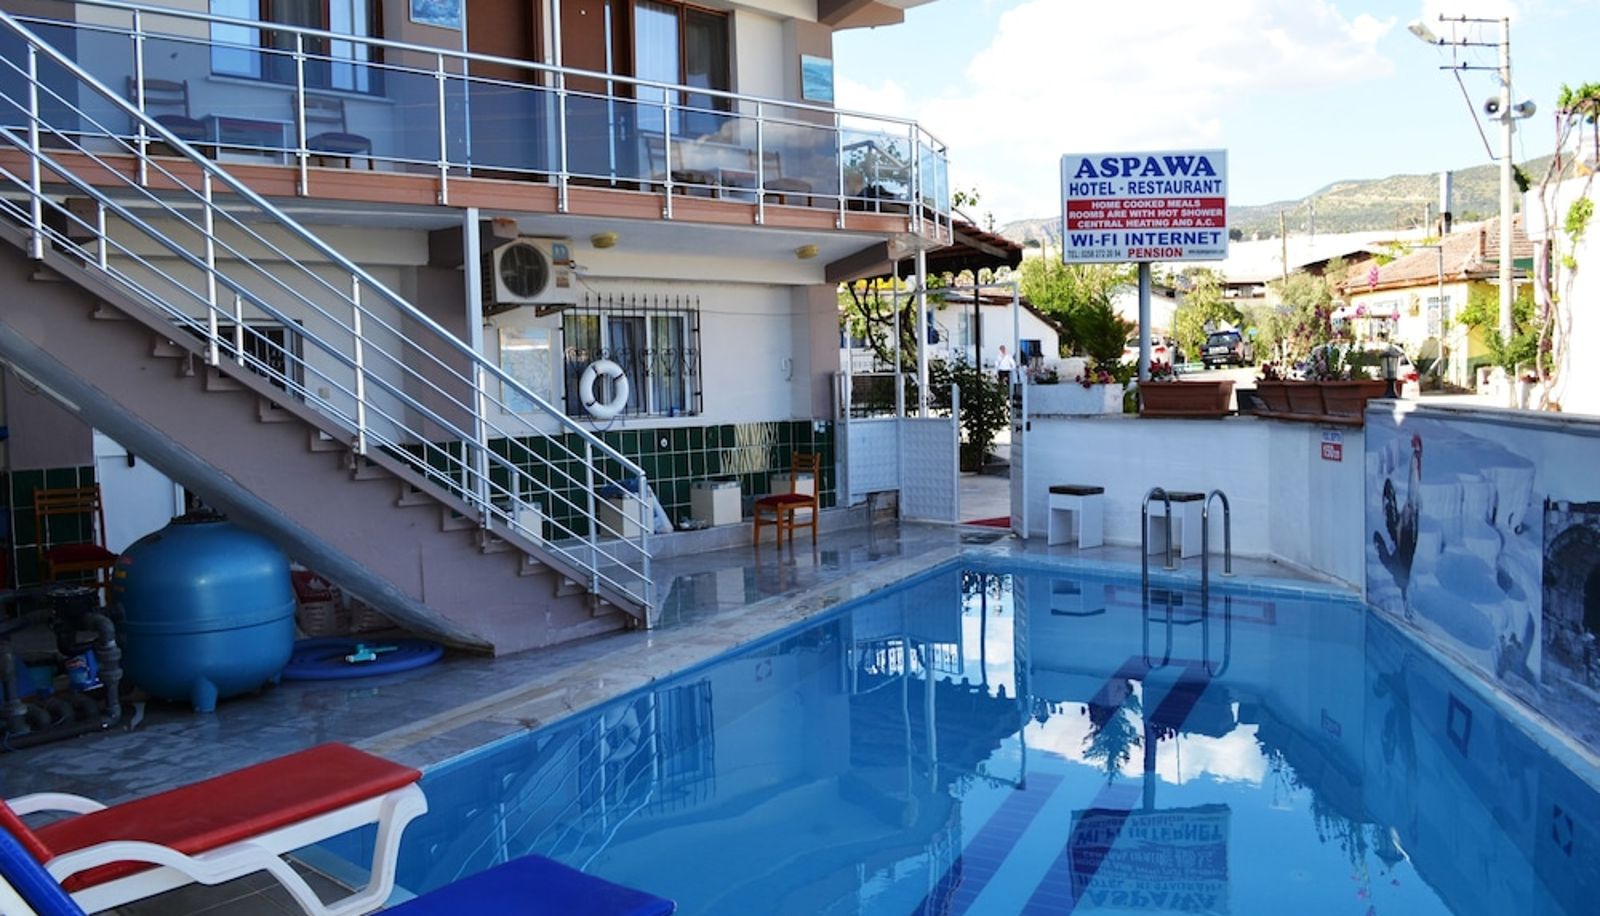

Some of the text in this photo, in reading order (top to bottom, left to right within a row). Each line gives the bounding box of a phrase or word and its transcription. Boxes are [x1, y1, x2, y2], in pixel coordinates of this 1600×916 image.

[1074, 156, 1217, 179] ASPAWA
[1069, 182, 1116, 196] HOTEL
[1127, 180, 1222, 194] RESTAURANT
[1091, 199, 1201, 209] HOME COOKED MEALS
[1069, 208, 1224, 219] ROOMS ARE WITH HOT SHOWER
[1077, 218, 1216, 228] CENTRAL HEATING AND A.C.
[1071, 232, 1222, 247] WI-FI INTERNET
[1127, 248, 1183, 258] PENSION
